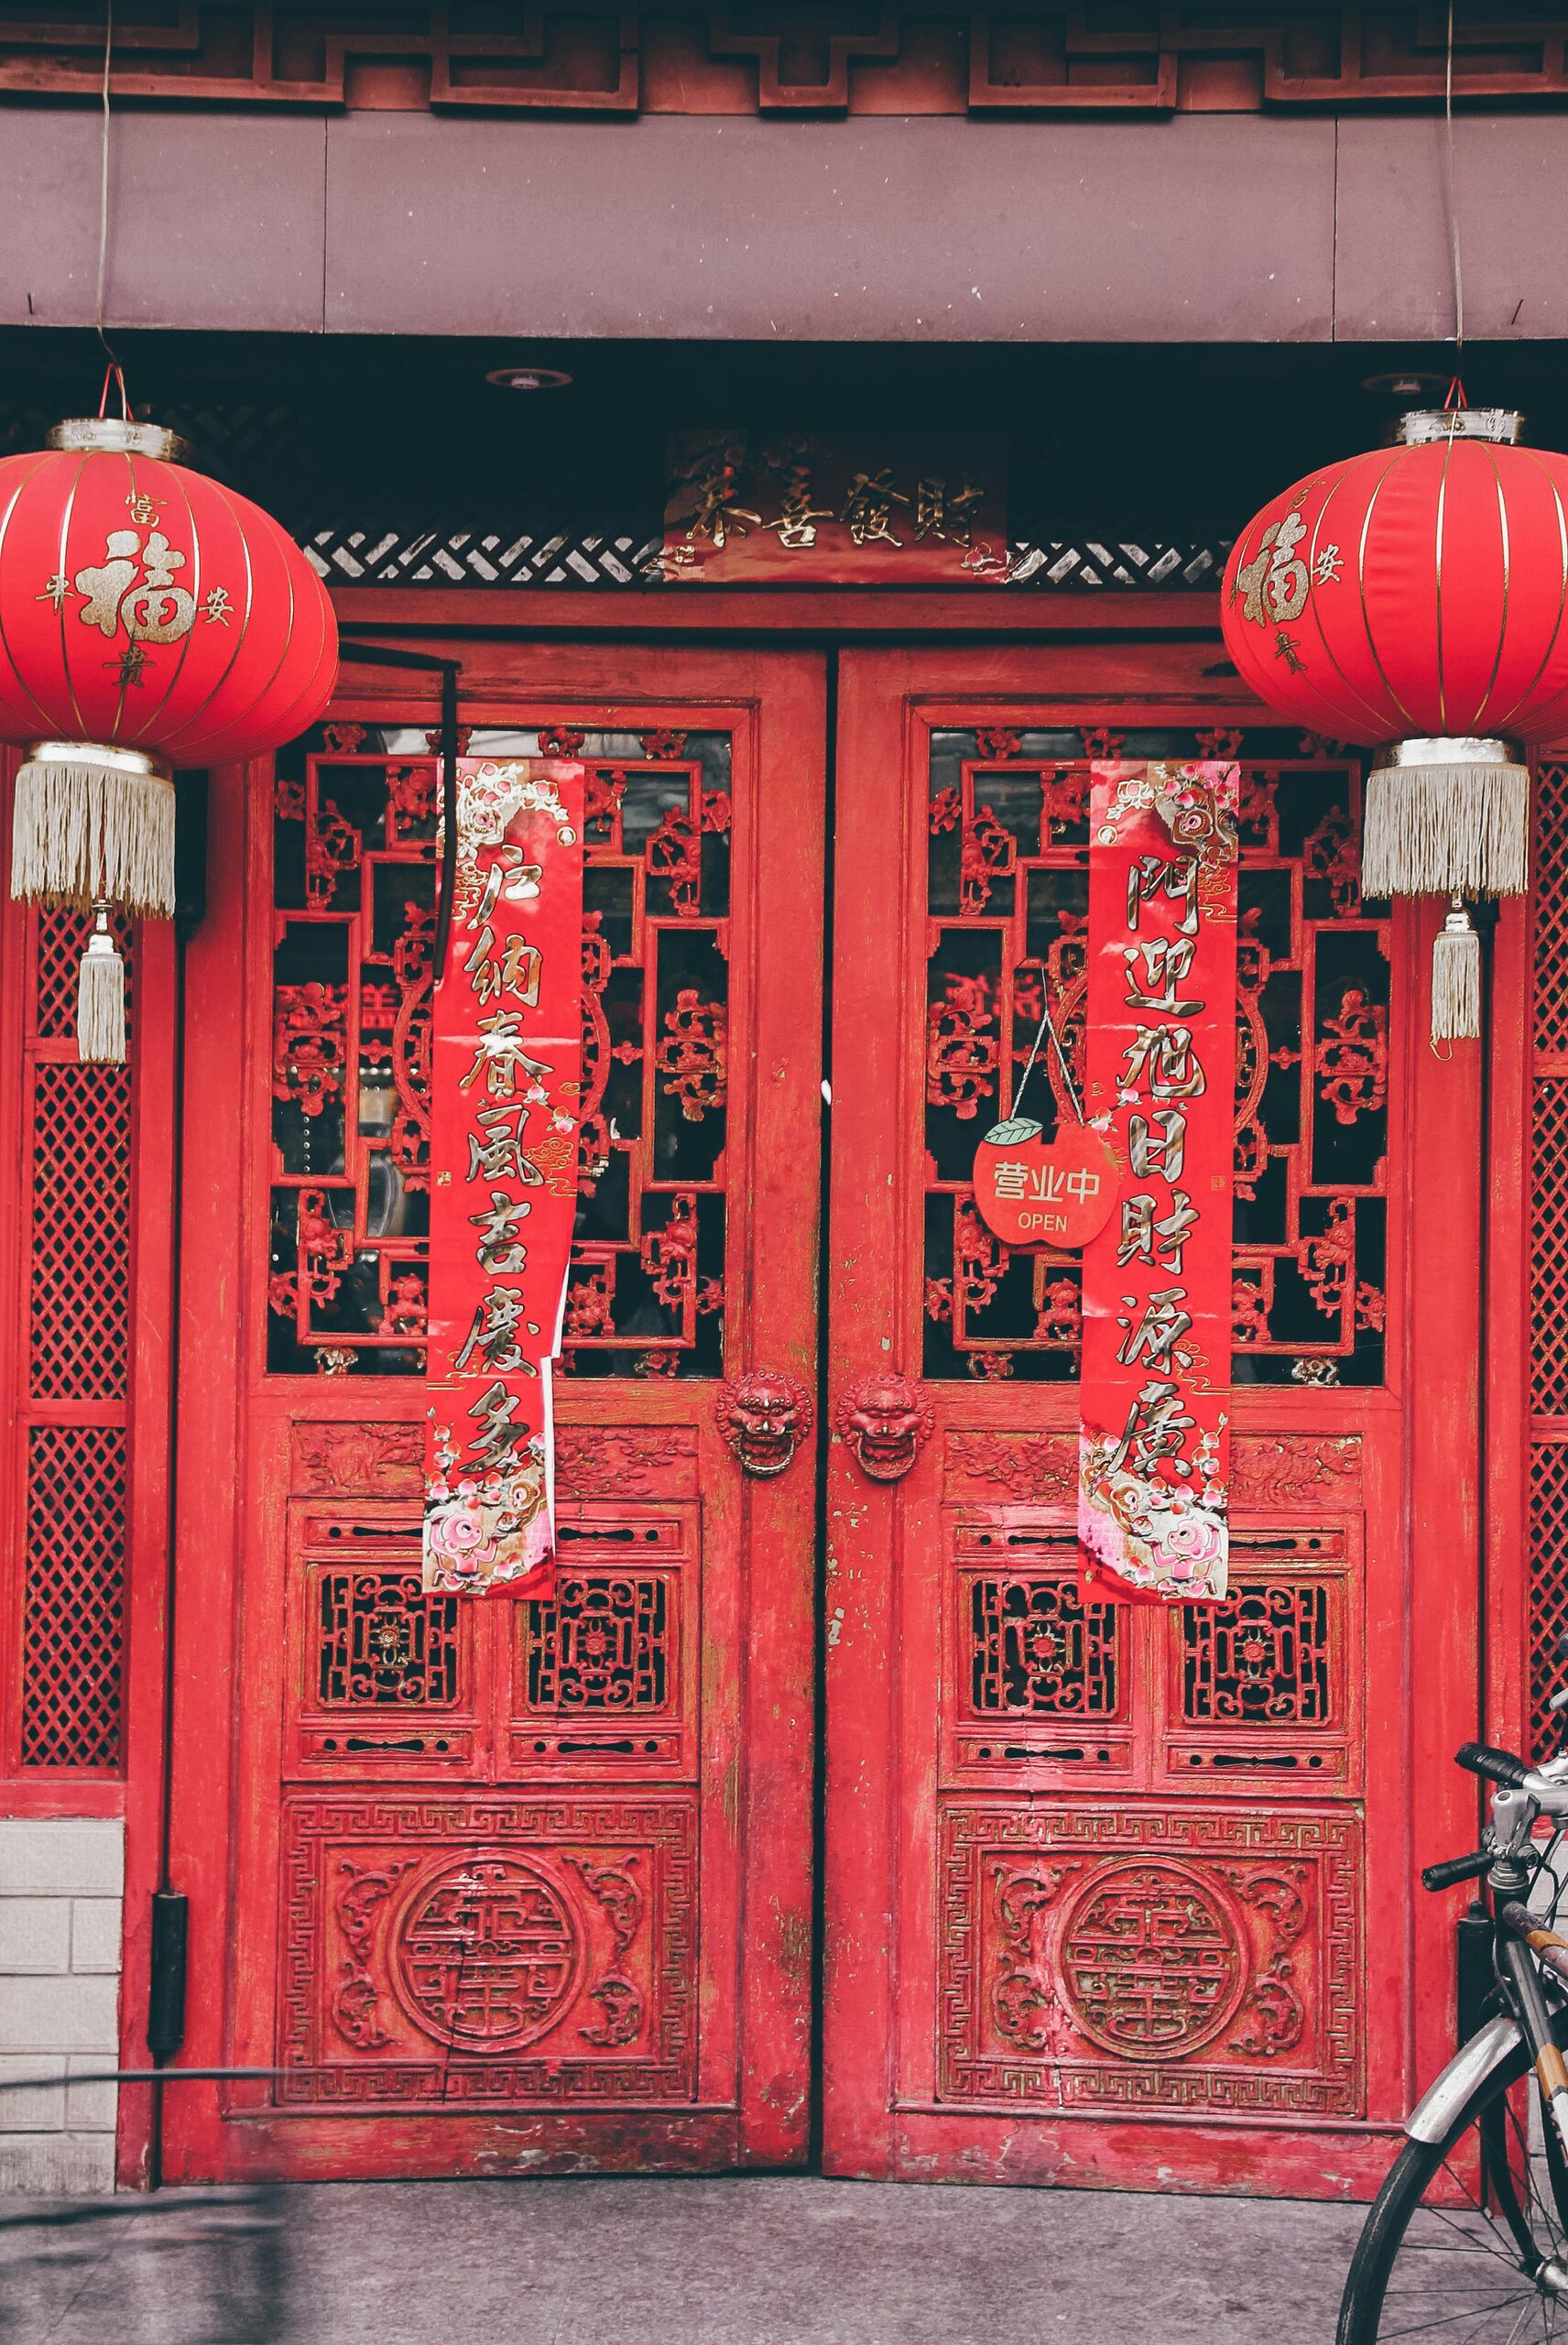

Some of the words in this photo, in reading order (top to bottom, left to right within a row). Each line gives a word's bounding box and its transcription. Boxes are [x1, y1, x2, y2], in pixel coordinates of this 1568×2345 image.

[684, 464, 985, 549] 恭喜發財
[1237, 511, 1310, 629] 福
[1313, 543, 1345, 586] 安
[34, 573, 76, 616] 平
[73, 529, 196, 645] 福
[197, 585, 235, 628] 安
[993, 1161, 1101, 1205] 营业中
[1018, 1211, 1069, 1232] OPEN
